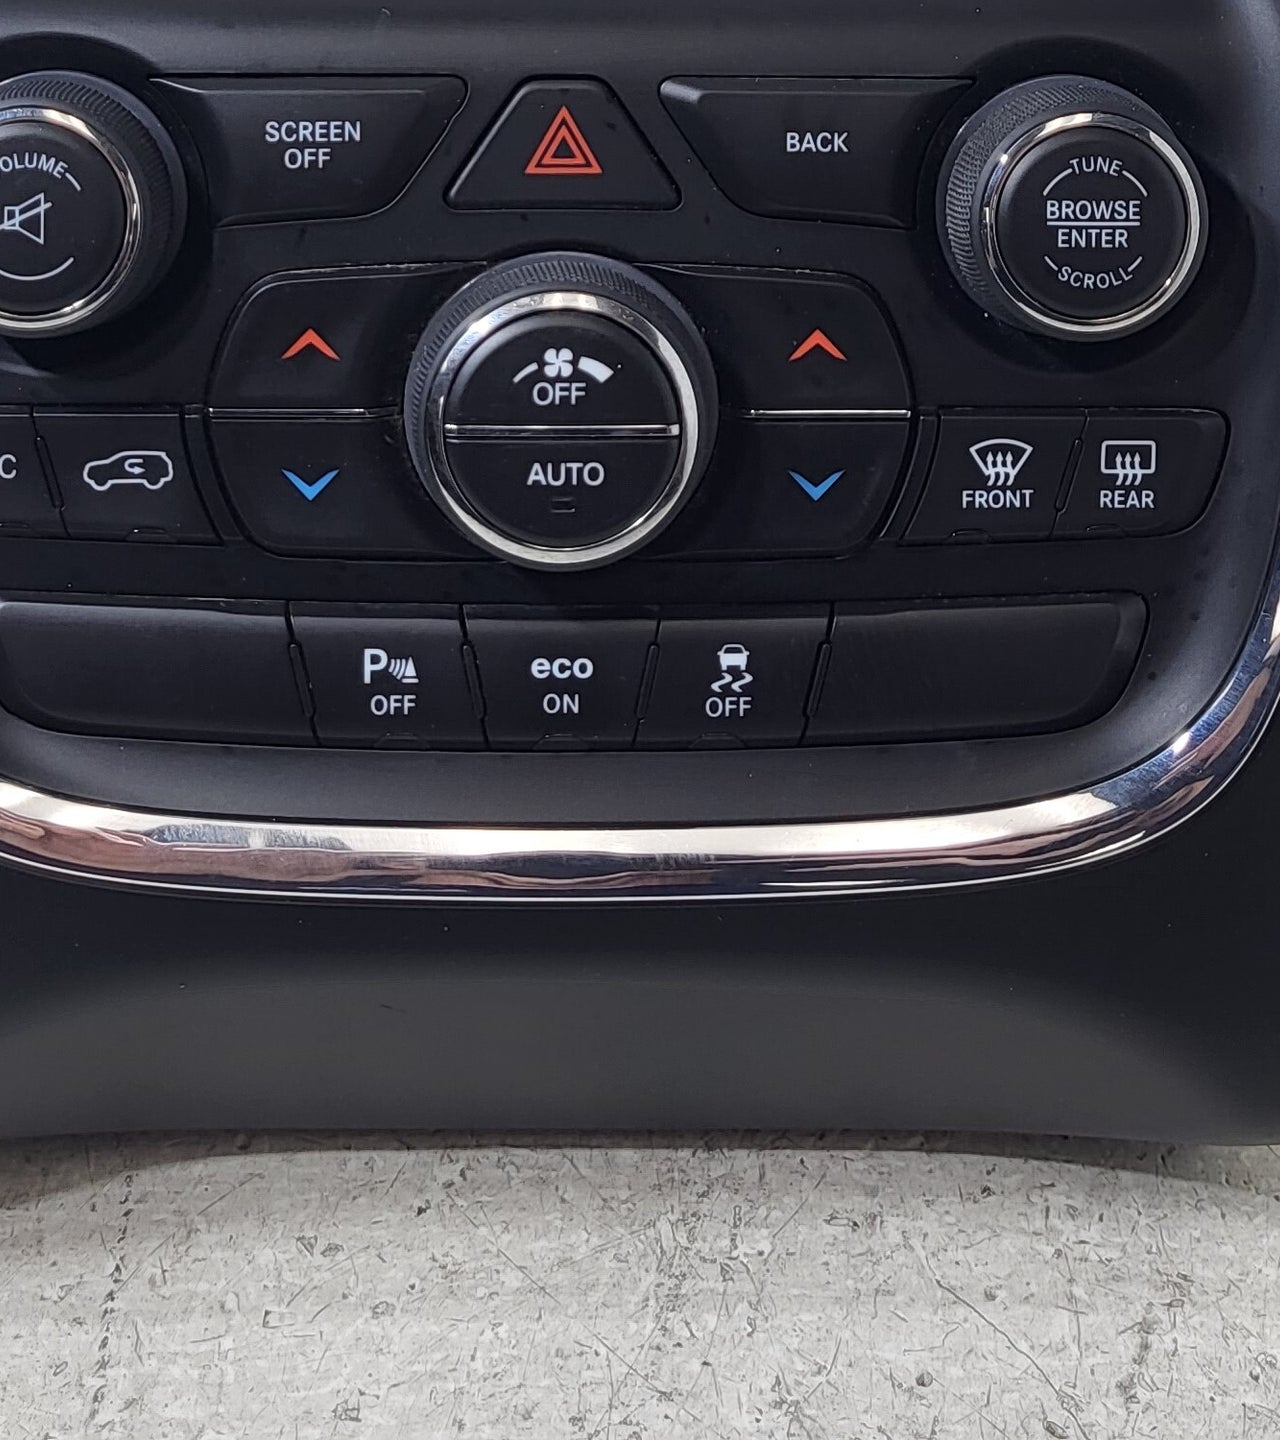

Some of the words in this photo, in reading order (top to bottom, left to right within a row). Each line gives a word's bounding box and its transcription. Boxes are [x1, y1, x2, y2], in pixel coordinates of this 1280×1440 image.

[264, 120, 362, 144] SCREEN
[785, 130, 850, 154] BACK
[283, 147, 333, 170] OFF
[1068, 155, 1123, 177] TUNE
[1045, 199, 1142, 220] BROWSE
[1057, 227, 1129, 249] ENTER
[1057, 265, 1133, 290] SCROLL
[531, 381, 587, 407] OFF
[525, 461, 606, 488] AUTO
[961, 488, 1035, 510] FRONT
[1098, 488, 1156, 510] REAR
[363, 647, 389, 685] P
[529, 656, 595, 680] eco
[369, 693, 418, 717] OFF
[541, 692, 580, 715] ON
[704, 695, 753, 719] OFF
